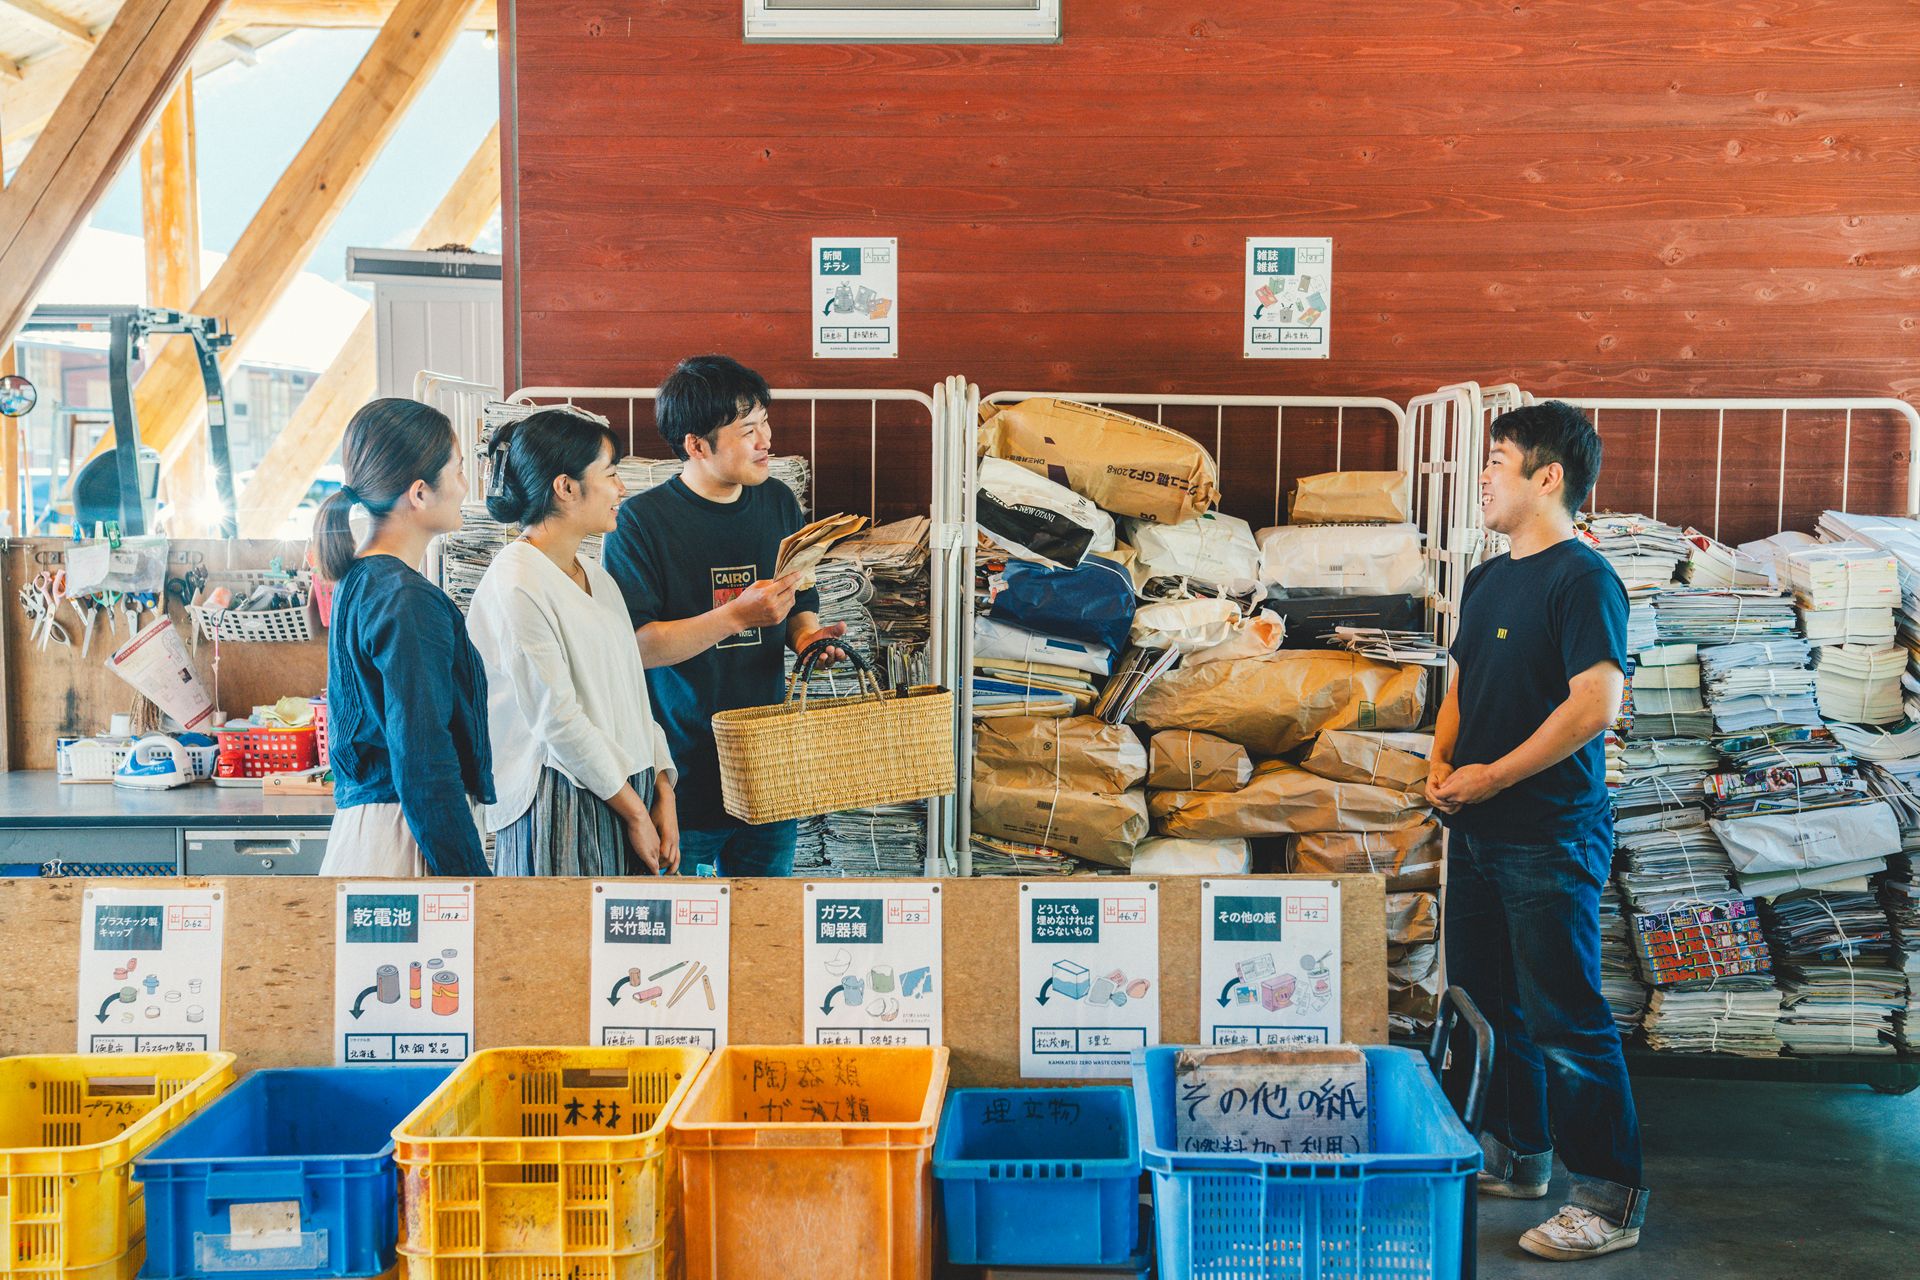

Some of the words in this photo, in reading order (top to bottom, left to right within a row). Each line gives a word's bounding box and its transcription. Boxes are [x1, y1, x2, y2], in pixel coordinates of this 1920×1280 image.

[822, 250, 842, 261] 新聞
[1256, 249, 1279, 261] 雑誌
[823, 262, 850, 272] チラシ
[1256, 261, 1279, 273] 雑紙
[1106, 464, 1129, 476] 20kg
[1128, 468, 1156, 483] GF2
[1019, 505, 1035, 515] NEW
[1034, 508, 1057, 523] OTANI
[715, 571, 751, 585] CAIRO
[609, 905, 650, 920] 割り箸
[821, 904, 862, 920] ガラス
[1037, 904, 1080, 914] どうしても
[99, 916, 159, 927] プラスチック製
[353, 907, 412, 927] 乾電池
[905, 913, 920, 922] 23
[1036, 914, 1094, 925] 埋めなければ
[1218, 911, 1277, 924] その他の紙
[99, 927, 133, 938] キャップ
[609, 921, 666, 936] 木竹製品
[820, 922, 867, 938] 陶器類
[1036, 926, 1093, 937] ならないもの
[655, 1034, 701, 1046] 固形燃料
[1035, 1036, 1071, 1049] 松茂町
[350, 1049, 377, 1059] 北海道
[398, 1043, 450, 1054] 鉄鋼製品
[1182, 1077, 1367, 1122] その他の紙
[563, 1096, 622, 1129] 木材
[981, 1096, 1081, 1126] 埋立物
